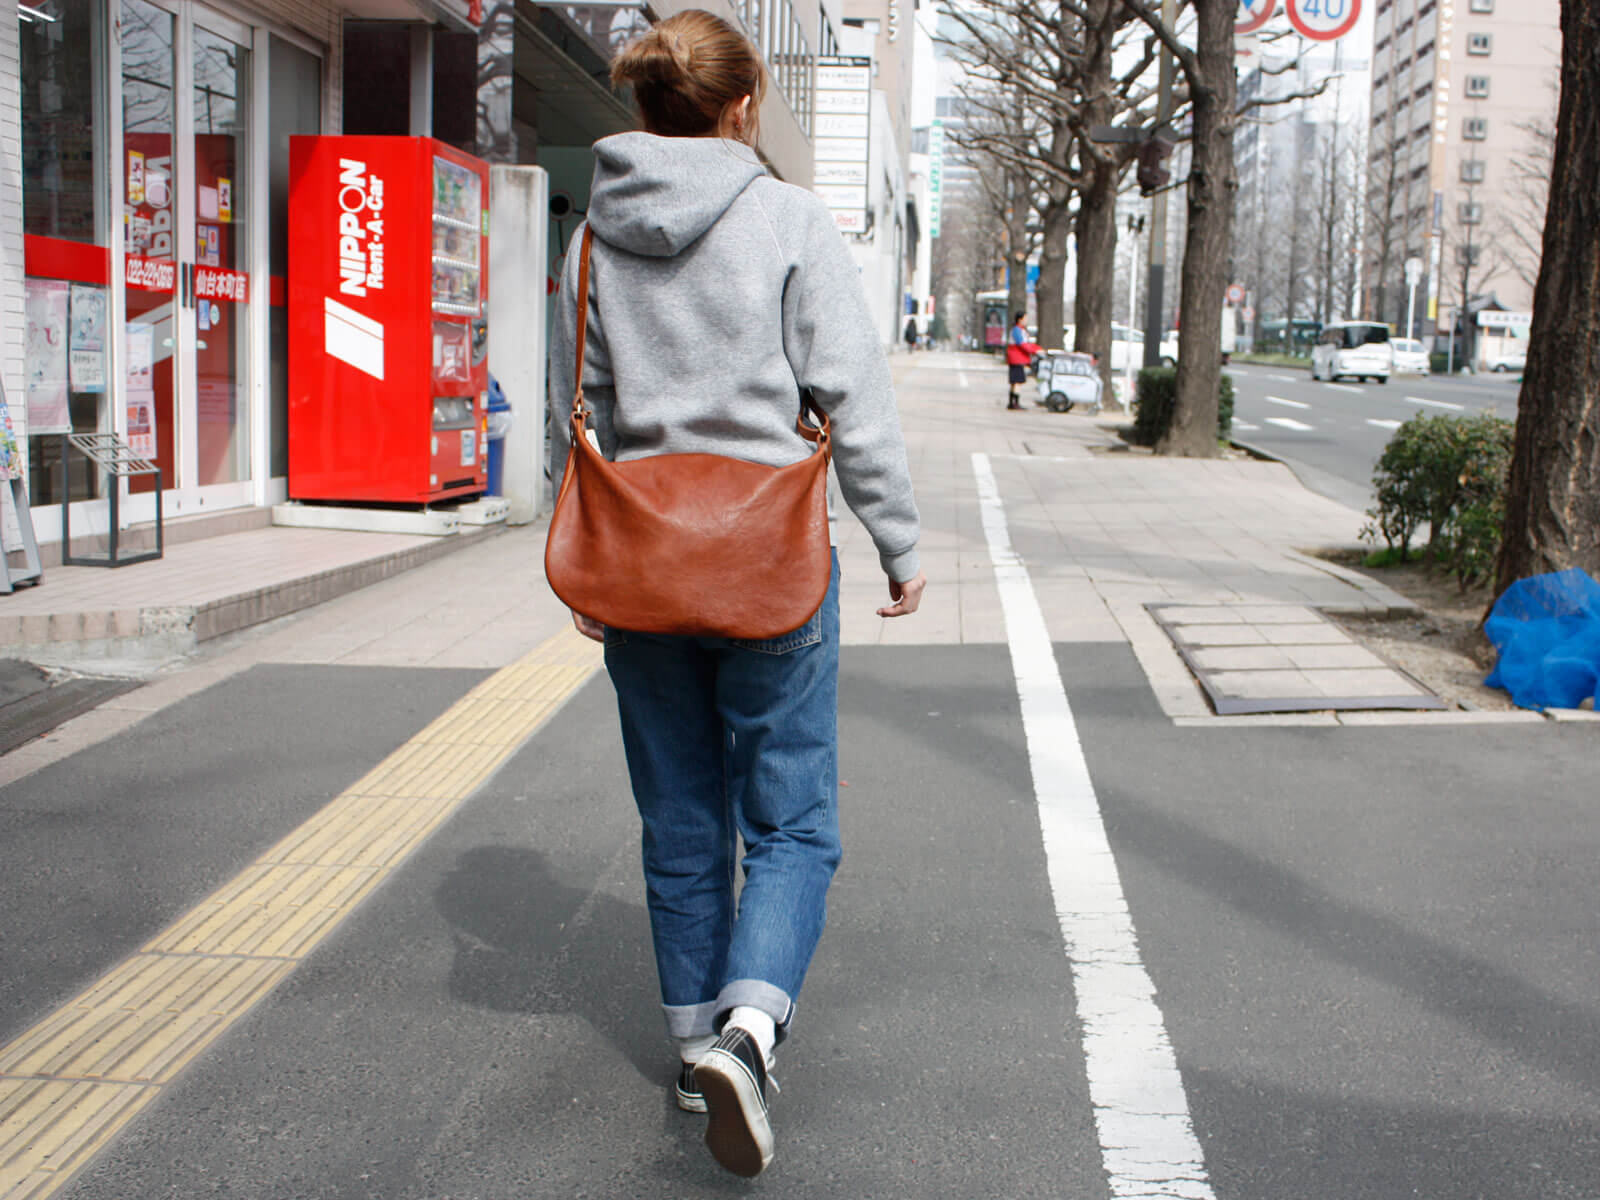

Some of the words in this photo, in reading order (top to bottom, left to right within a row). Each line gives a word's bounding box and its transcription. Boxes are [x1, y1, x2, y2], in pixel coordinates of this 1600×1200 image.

[196, 269, 247, 300] 仙台本町店
[339, 157, 367, 298] NIPPON
[366, 174, 384, 289] Rent-A-Car
